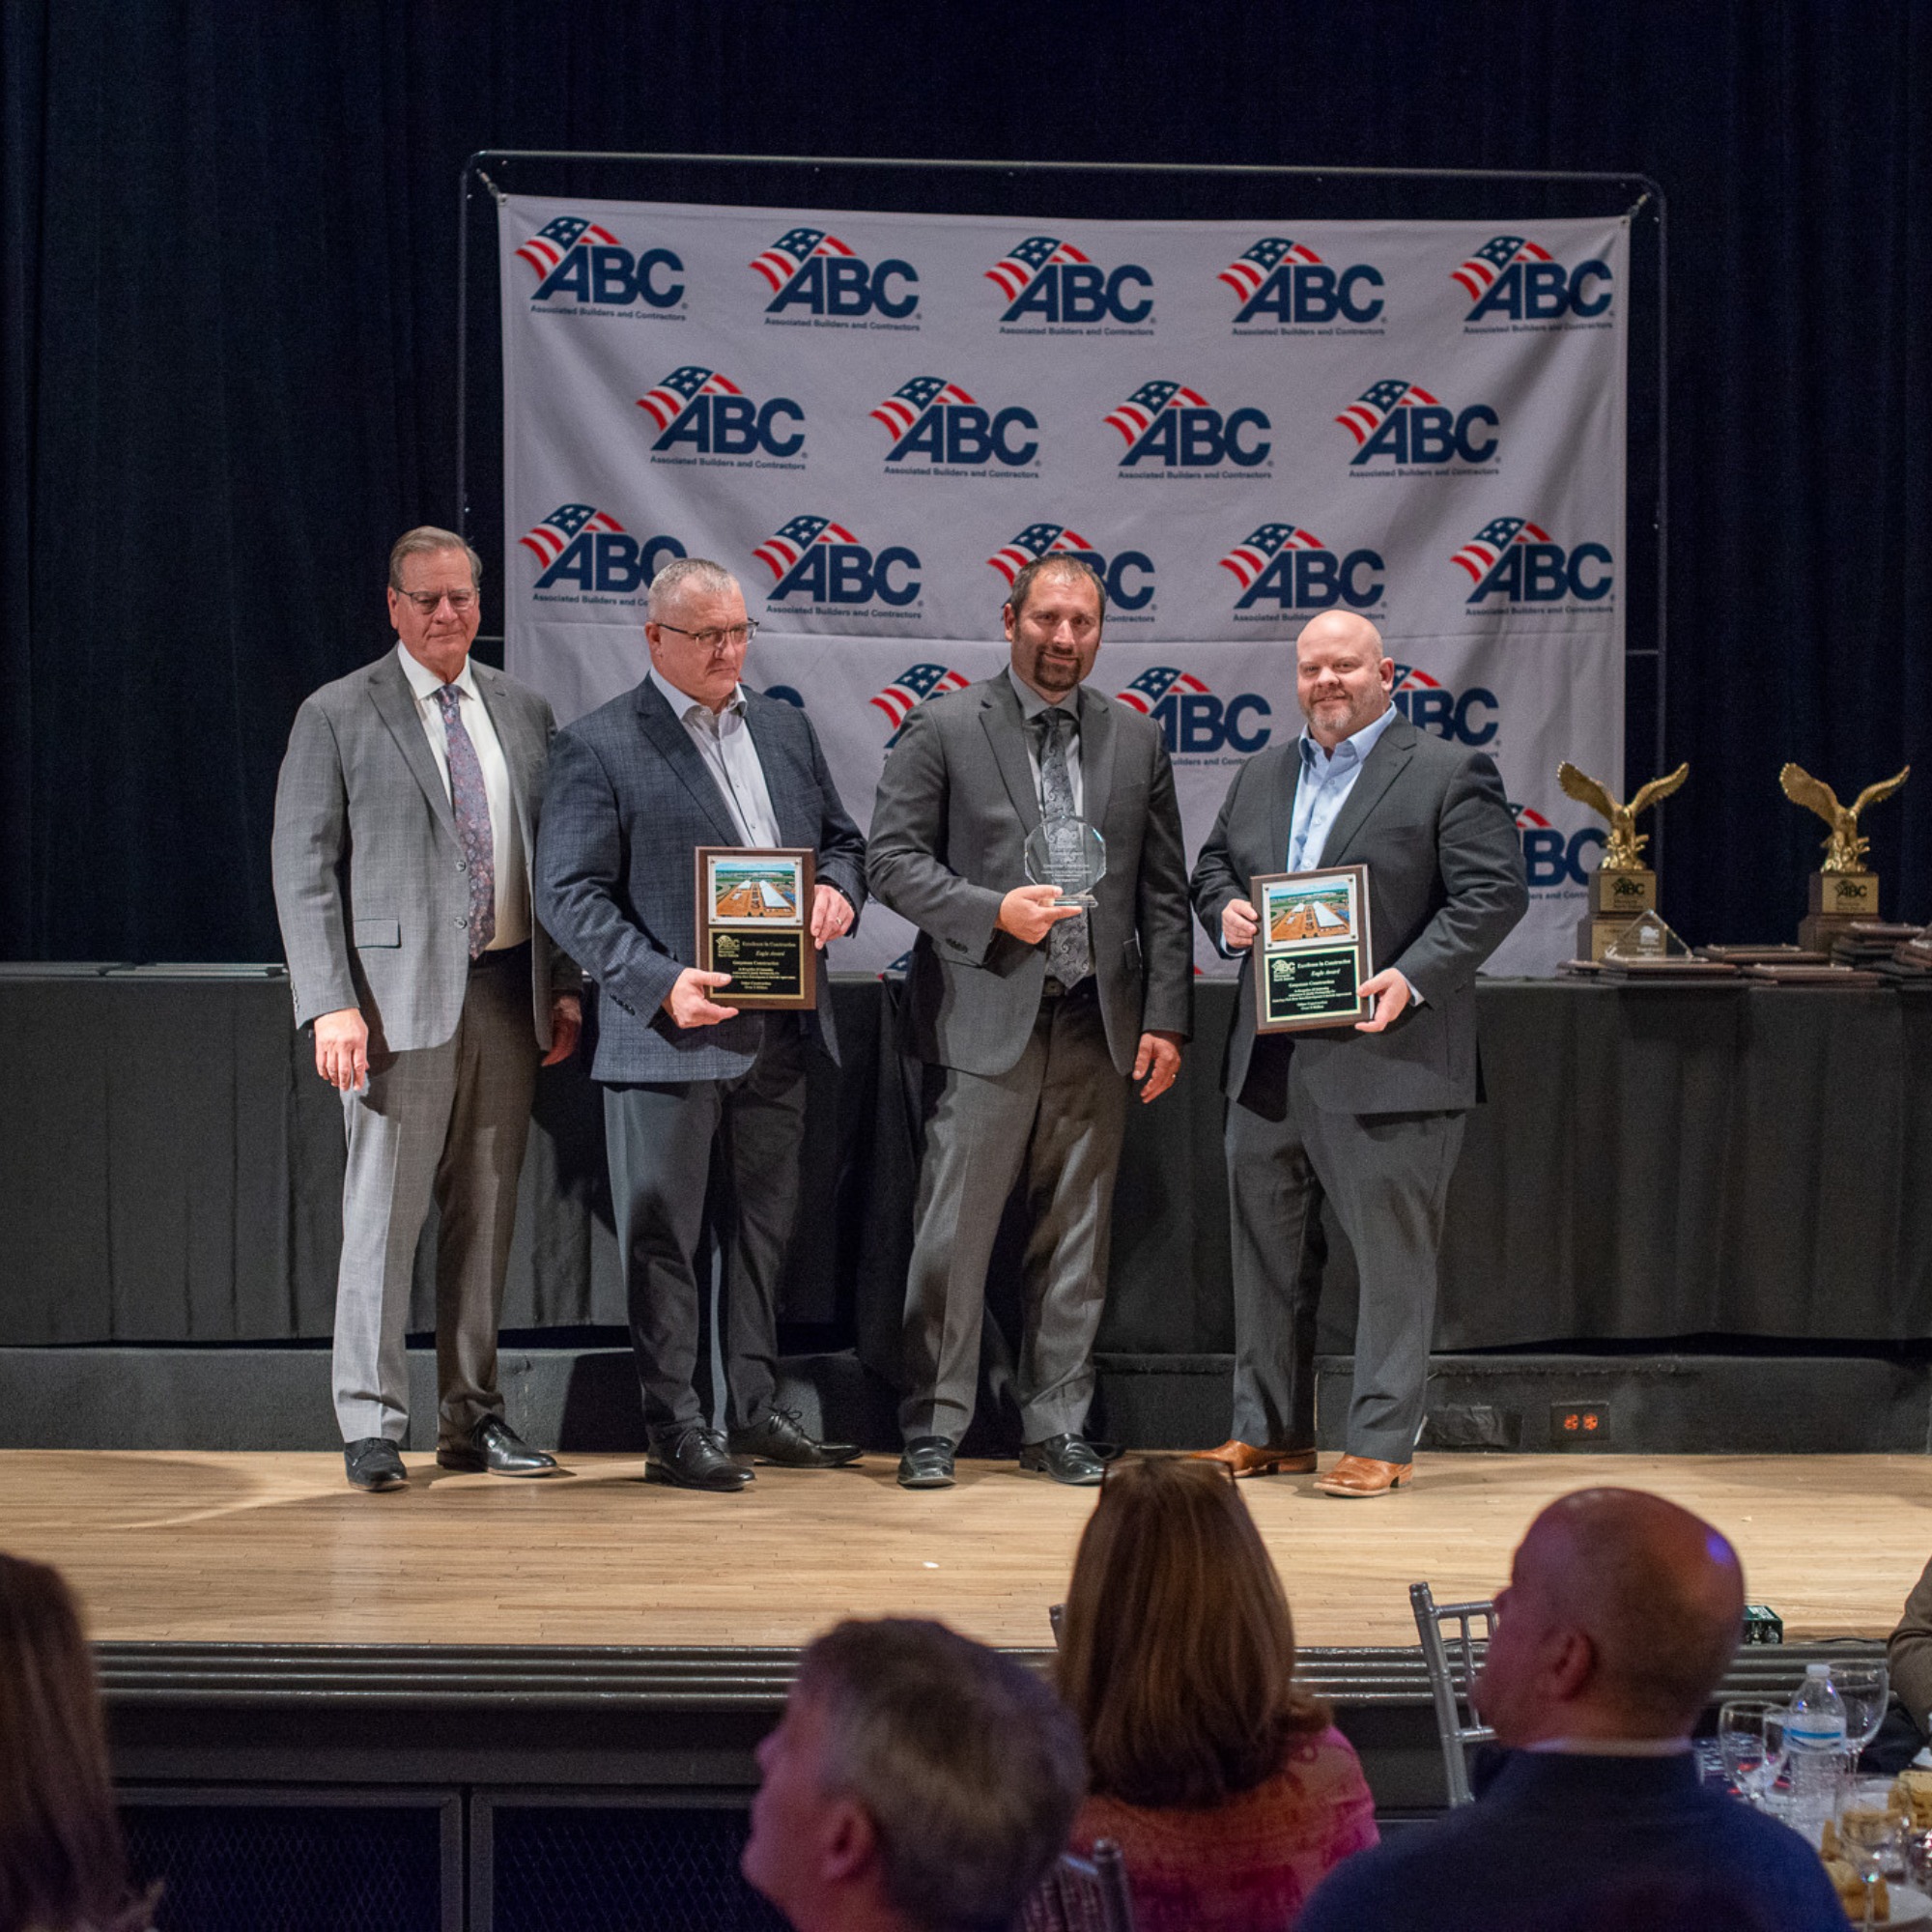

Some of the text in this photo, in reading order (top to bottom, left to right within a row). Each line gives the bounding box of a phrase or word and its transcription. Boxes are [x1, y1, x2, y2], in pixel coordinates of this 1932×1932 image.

[530, 245, 685, 308] ABC
[764, 257, 920, 319] ABC
[999, 265, 1154, 325] ABC
[1232, 266, 1384, 324] ABC
[1463, 259, 1611, 322] ABC
[530, 305, 578, 315] Associated
[580, 308, 615, 318] Builders
[635, 310, 686, 322] Contractors
[764, 318, 812, 327] Associated
[813, 320, 849, 328] Builders
[868, 322, 921, 331] Contractors
[1103, 327, 1154, 336] Contractors
[1334, 327, 1385, 336] Contractors
[1463, 326, 1510, 334] Associated
[1564, 322, 1612, 330] Contractors
[650, 395, 805, 458] ABC
[884, 405, 1038, 467] ABC
[1118, 407, 1271, 467] ABC
[1349, 404, 1500, 466] ABC
[650, 456, 697, 465] Associated
[699, 458, 735, 467] Builders
[754, 460, 806, 469] Contractors
[884, 466, 931, 474] Associated
[932, 468, 969, 476] Builders
[988, 469, 1039, 479] Contractors
[1221, 470, 1272, 479] Contractors
[1434, 468, 1450, 476] and
[766, 544, 922, 607] ABC
[1234, 549, 1385, 610] ABC
[1465, 542, 1611, 604] ABC
[533, 593, 580, 603] Associated
[582, 595, 617, 605] Builders
[619, 598, 636, 607] and
[766, 605, 923, 619] Associated Builders and Contractors
[1564, 605, 1613, 613] Contractors
[1105, 614, 1154, 623] Contractors
[1392, 687, 1499, 746] BC
[1614, 882, 1645, 895] ABC
[1837, 884, 1867, 897] ABC
